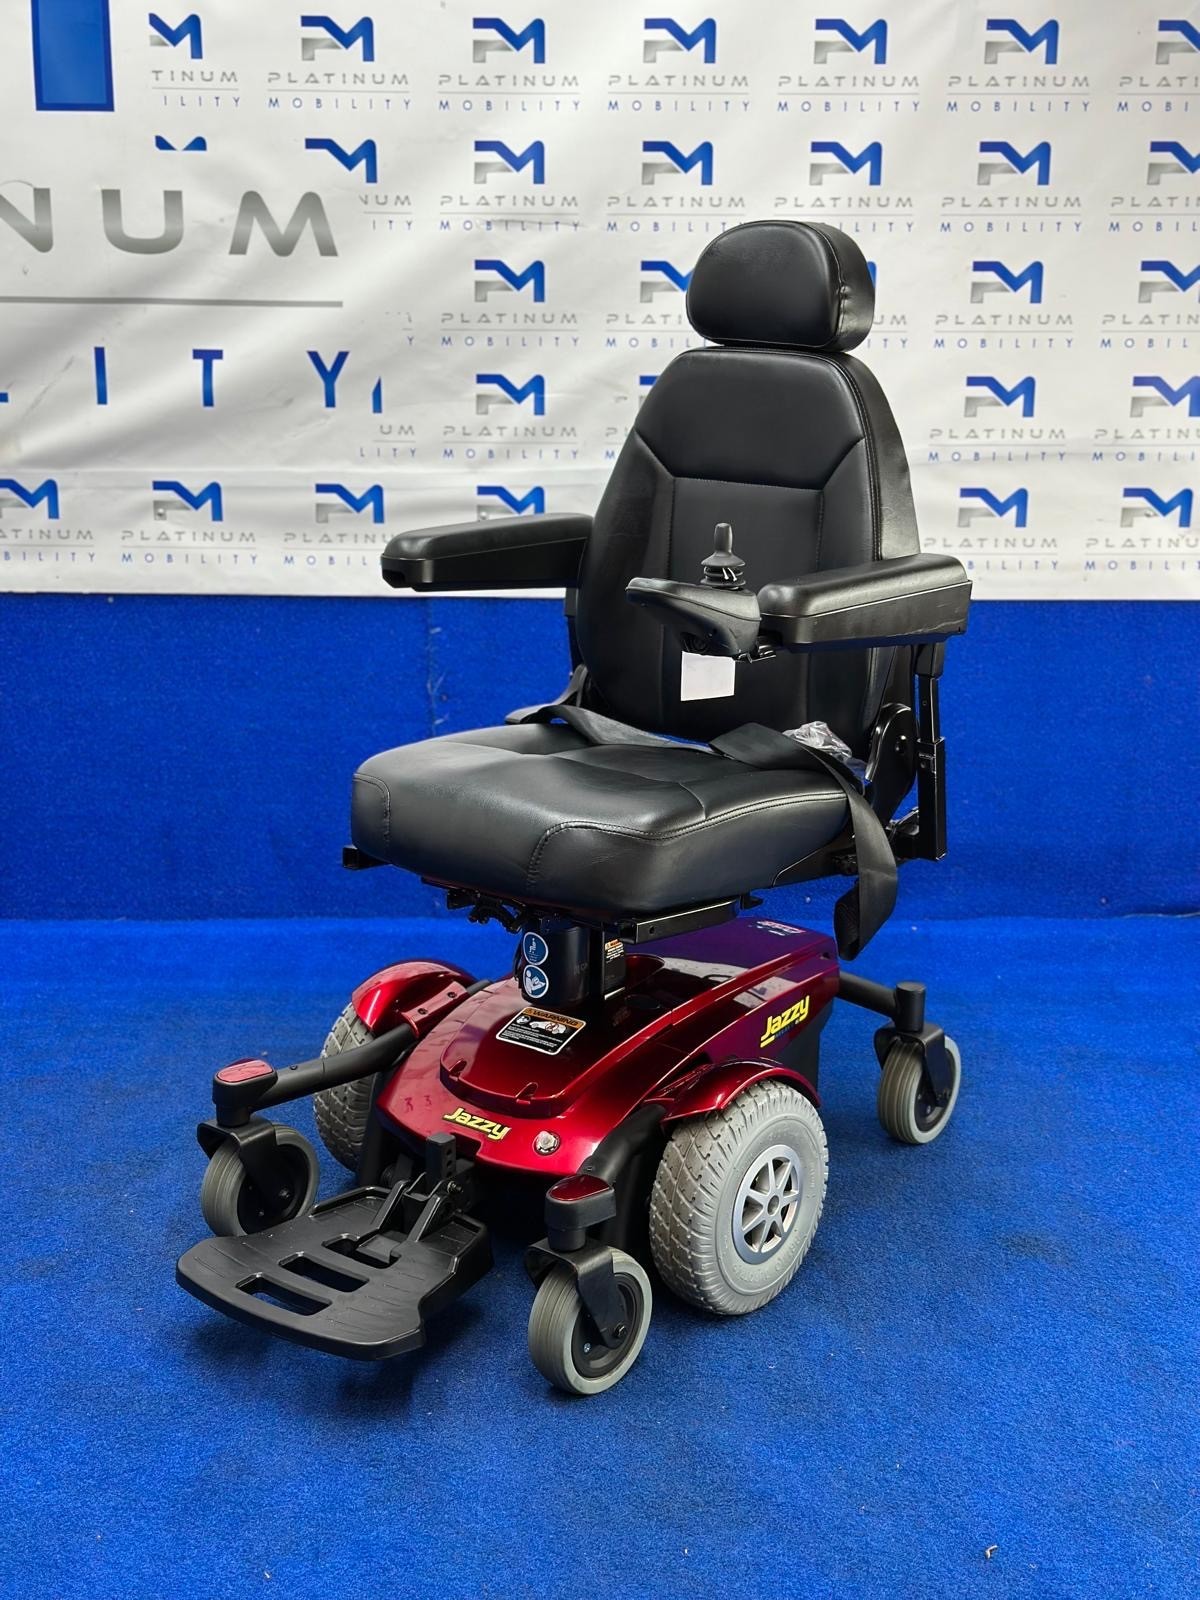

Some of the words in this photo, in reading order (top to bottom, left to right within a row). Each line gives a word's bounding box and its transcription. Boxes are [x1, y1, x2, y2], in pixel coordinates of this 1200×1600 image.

[151, 70, 238, 82] TINUM
[267, 72, 409, 85] PLATINUM
[438, 74, 579, 86] PLATINUM
[608, 74, 749, 87] PLATINUM
[778, 75, 919, 88] PLATINUM
[948, 75, 1090, 88] PLATINUM
[163, 95, 240, 107] ILITY
[268, 97, 411, 109] MOBILITY
[438, 99, 580, 112] MOBILITY
[607, 100, 750, 112] MOBILITY
[776, 100, 920, 113] MOBILITY
[946, 100, 1090, 113] MOBILITY
[1116, 100, 1189, 113] MOBI
[440, 194, 579, 207] PLATINUM
[607, 195, 745, 208] PLATINUM
[774, 196, 913, 208] PLATINUM
[941, 196, 1081, 208] PLATINUM
[439, 219, 580, 231] MOBILITY
[607, 220, 745, 232] MOBILIT
[939, 221, 1082, 233] MOBILITY
[440, 312, 577, 324] PLATINUM
[935, 314, 1073, 326] PLATINUM
[441, 335, 579, 347] MOBILITY
[933, 337, 1073, 349] MOBILITY
[0, 346, 350, 408] ITY
[443, 425, 577, 437] PLATINUM
[929, 428, 1065, 439] PLATINUM
[442, 448, 579, 460] MOBILITY
[927, 452, 1068, 464] MOBILITY
[121, 530, 256, 543] PLATINUM
[927, 537, 1057, 548] PLATINUM
[121, 552, 257, 564] MOBILITY
[760, 995, 810, 1043] Jazzy
[443, 1107, 512, 1141] Jazzy
